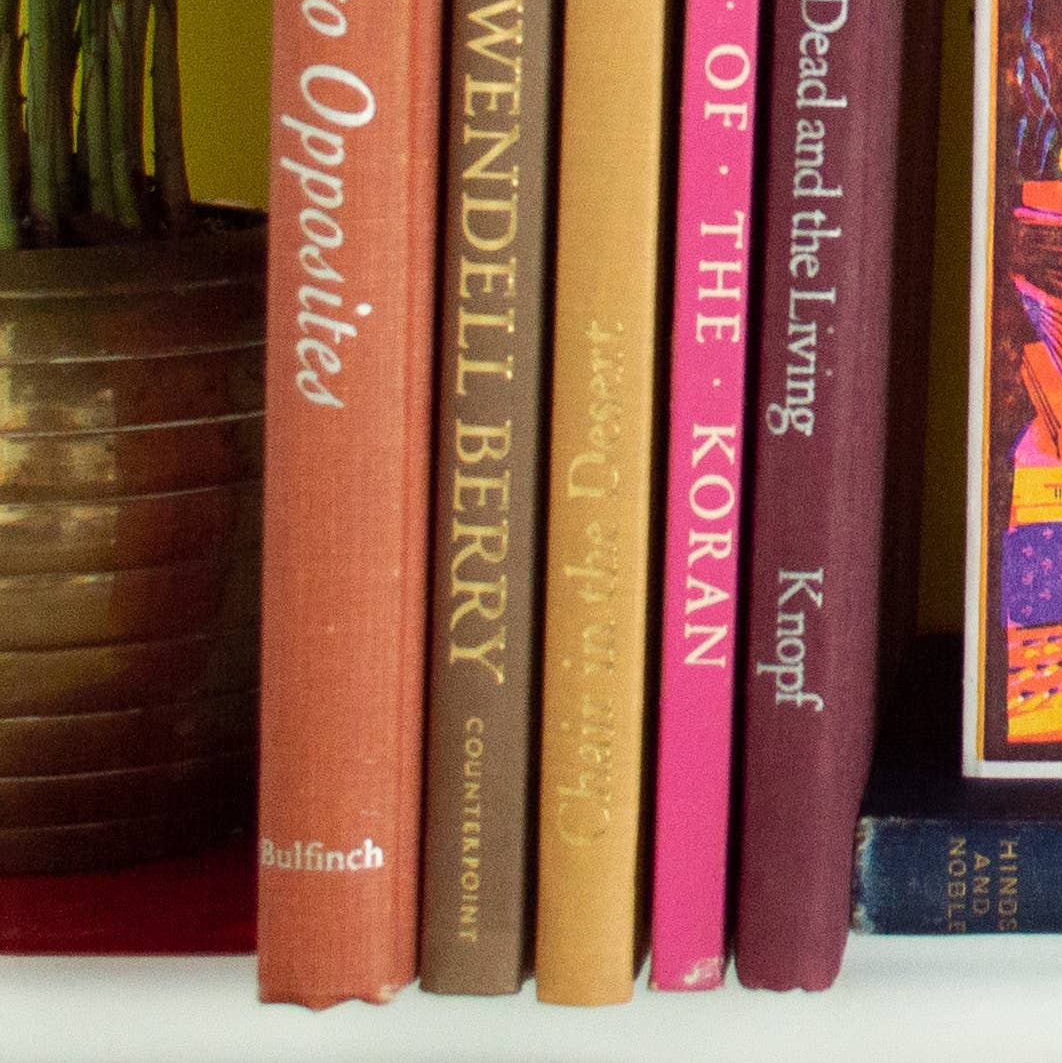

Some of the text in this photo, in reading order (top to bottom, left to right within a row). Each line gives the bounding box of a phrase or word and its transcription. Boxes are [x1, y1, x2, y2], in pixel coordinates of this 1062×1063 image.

[703, 44, 751, 131] OF
[793, 119, 842, 198] and
[280, 64, 378, 410] Opposites
[695, 212, 745, 343] THE
[789, 205, 842, 279] the
[566, 320, 624, 501] Desert
[766, 287, 836, 437] Living
[449, 418, 512, 684] BERRY
[566, 518, 618, 606] the
[684, 423, 736, 669] KORAN
[756, 568, 824, 711] Knopf
[260, 838, 385, 872] Bulfinch
[457, 716, 485, 944] COUNTERPOINT
[949, 837, 967, 932] NOBLE
[973, 852, 991, 914] AND
